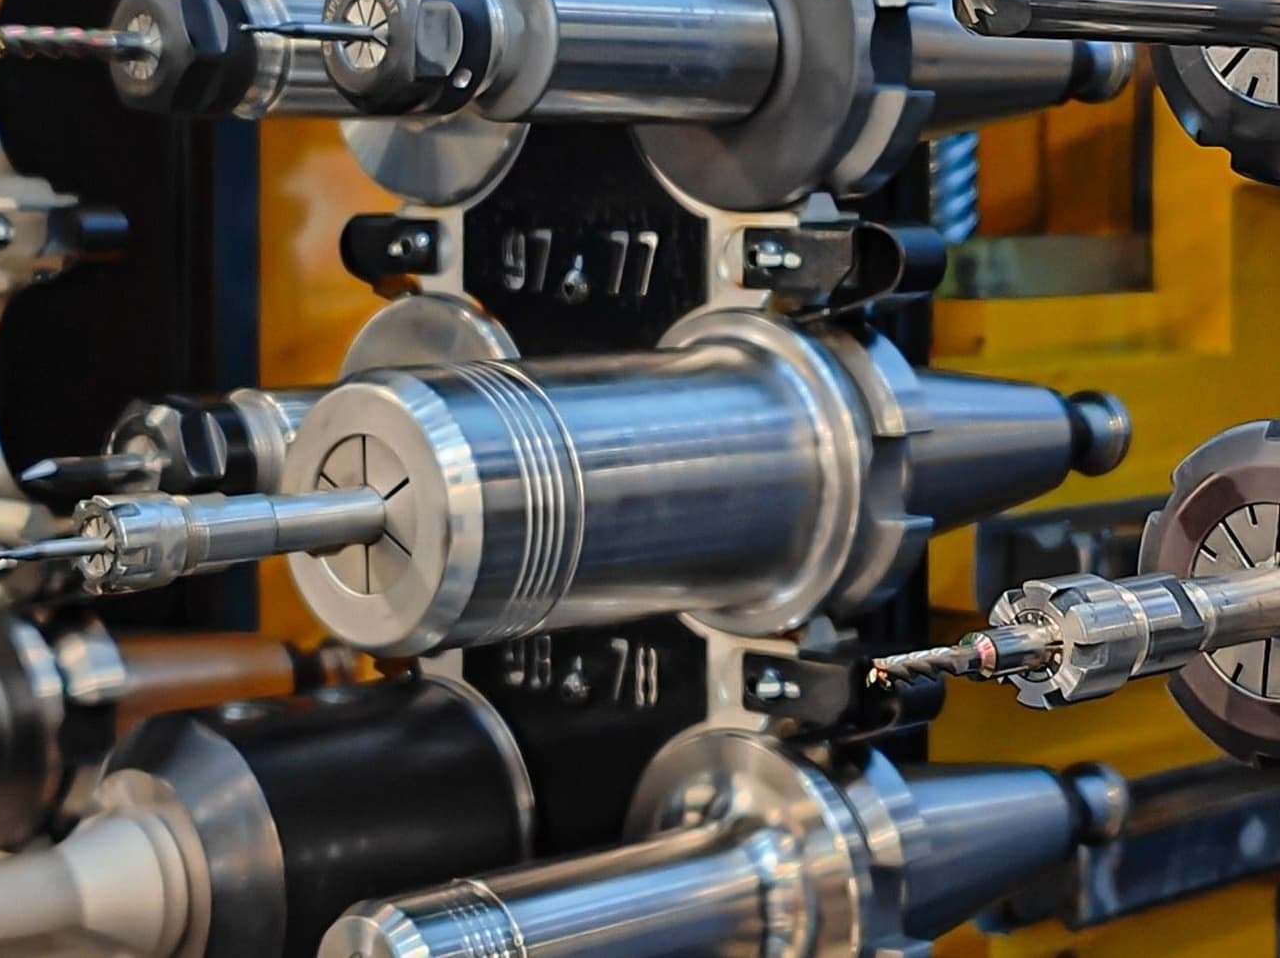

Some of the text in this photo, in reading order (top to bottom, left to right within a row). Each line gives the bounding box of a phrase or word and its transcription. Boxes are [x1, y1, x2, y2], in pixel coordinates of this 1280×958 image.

[503, 227, 659, 296] 97 77
[609, 637, 659, 708] 78
